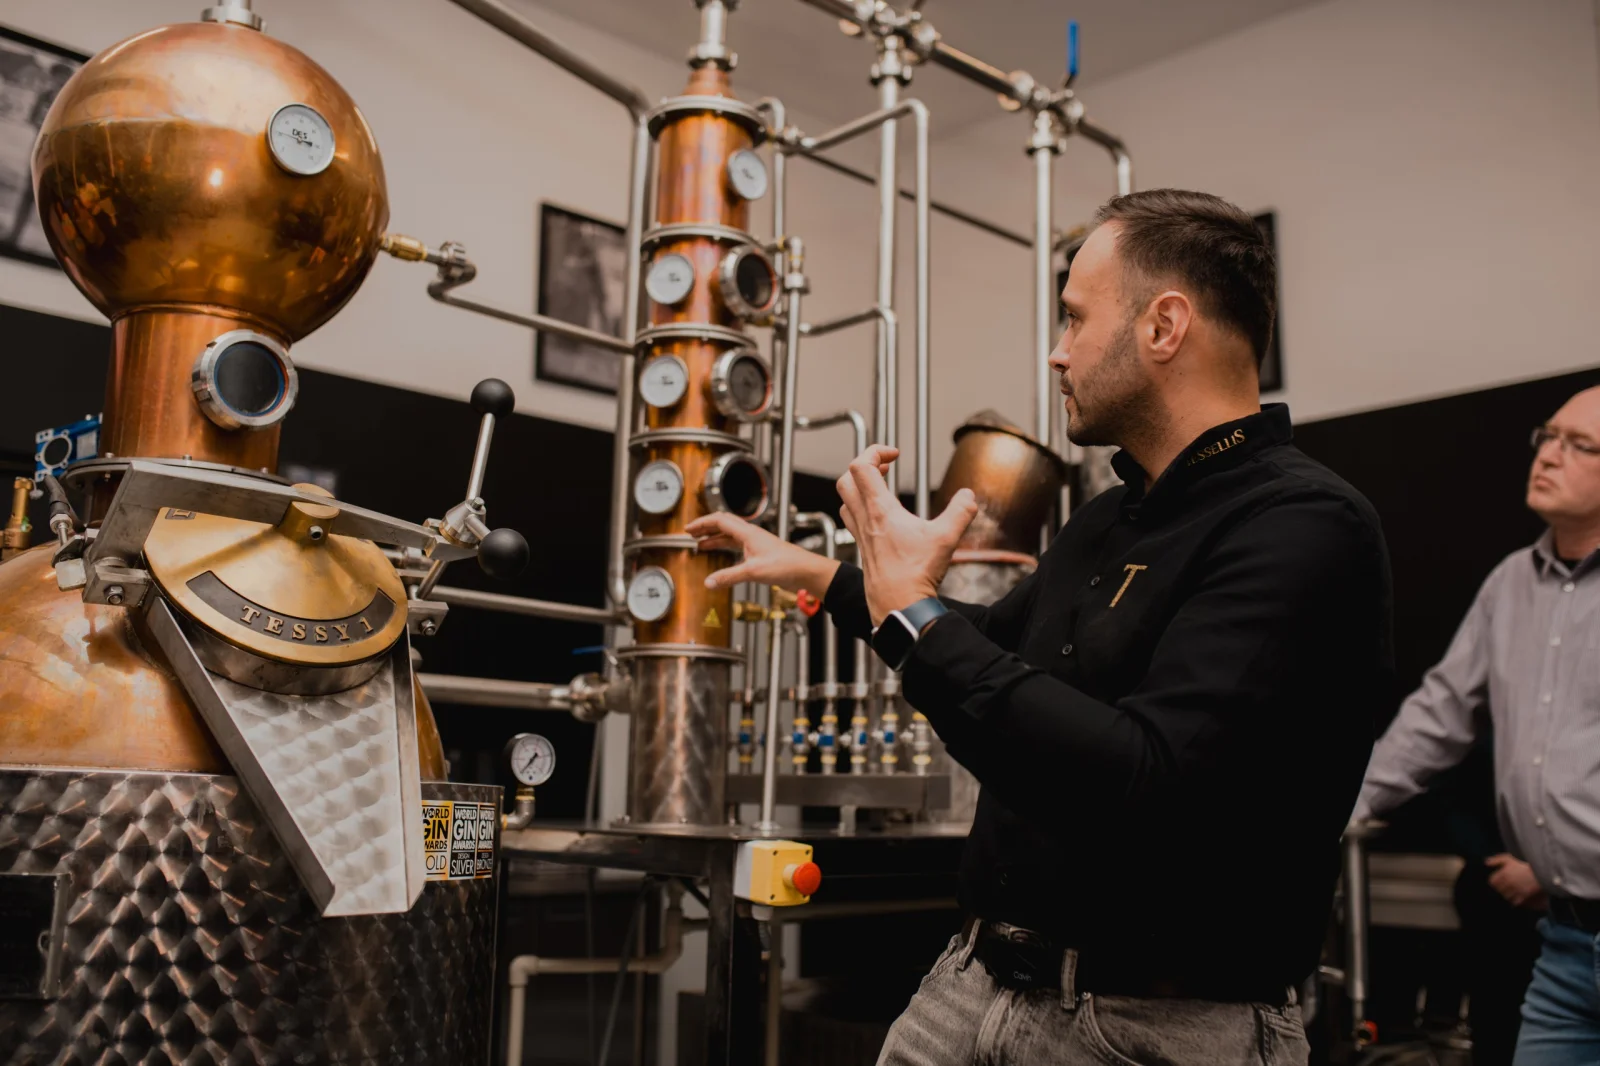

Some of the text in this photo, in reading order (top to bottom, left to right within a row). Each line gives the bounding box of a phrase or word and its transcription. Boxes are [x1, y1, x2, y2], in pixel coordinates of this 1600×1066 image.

[1109, 564, 1148, 607] T
[240, 605, 374, 642] TESSY 1
[454, 809, 476, 820] WORLD
[423, 820, 448, 840] GIN
[454, 820, 476, 840] GIN
[479, 820, 494, 840] GIN
[424, 840, 448, 850] WARDS
[452, 840, 476, 850] AWARDS
[426, 855, 447, 870] OLD
[451, 860, 474, 875] SILVER
